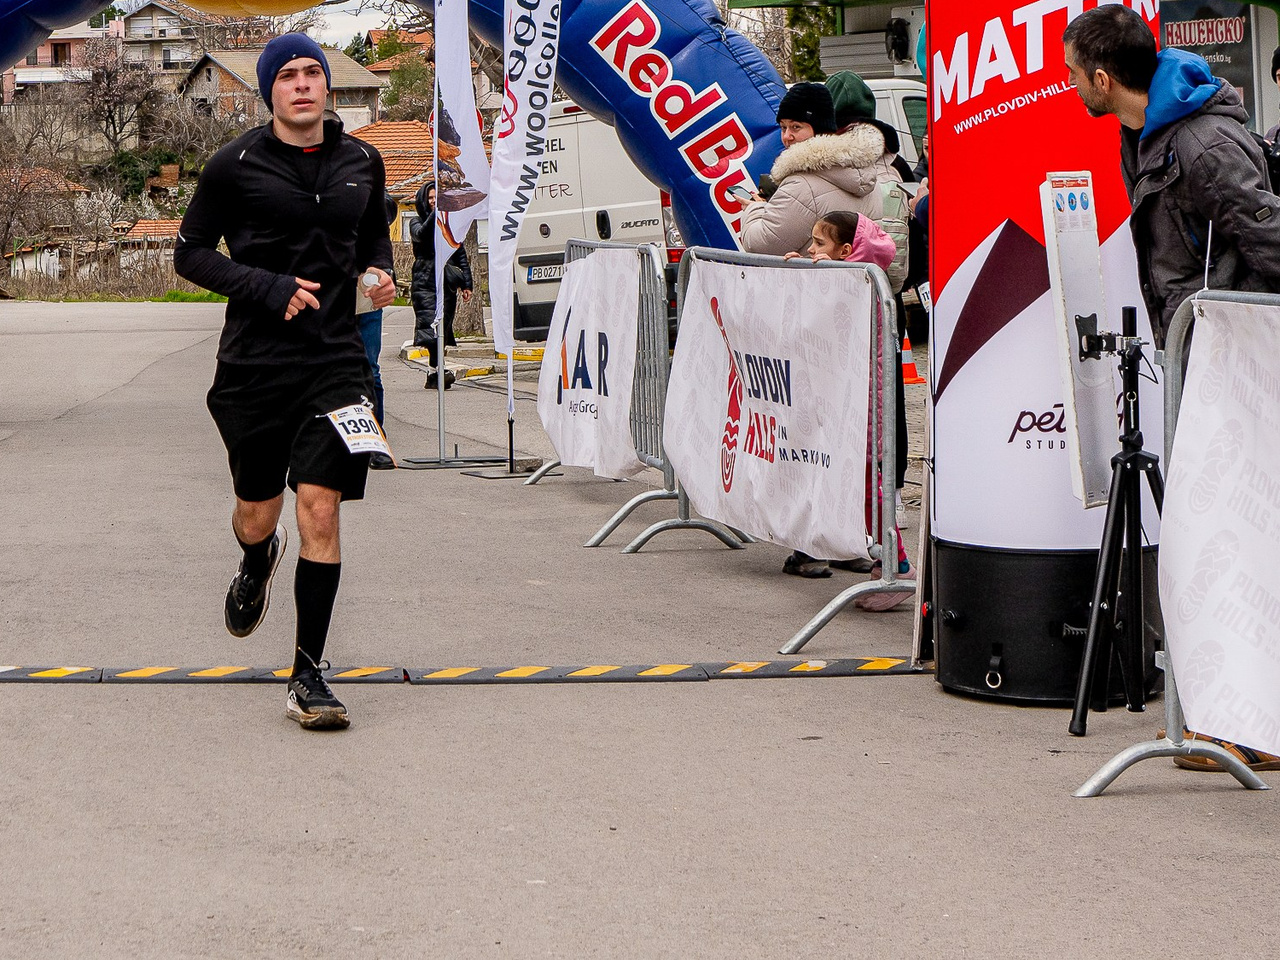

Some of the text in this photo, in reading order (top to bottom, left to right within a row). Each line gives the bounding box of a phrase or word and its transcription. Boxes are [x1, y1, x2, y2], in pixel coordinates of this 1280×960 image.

[1165, 16, 1244, 47] НАШЕНСКО
[953, 81, 1077, 135] WWW.PLOVDIV-HILL
[681, 114, 761, 247] Bu
[621, 218, 660, 229] DUCATO
[338, 418, 380, 436] 1390
[1026, 440, 1066, 450] STUD
